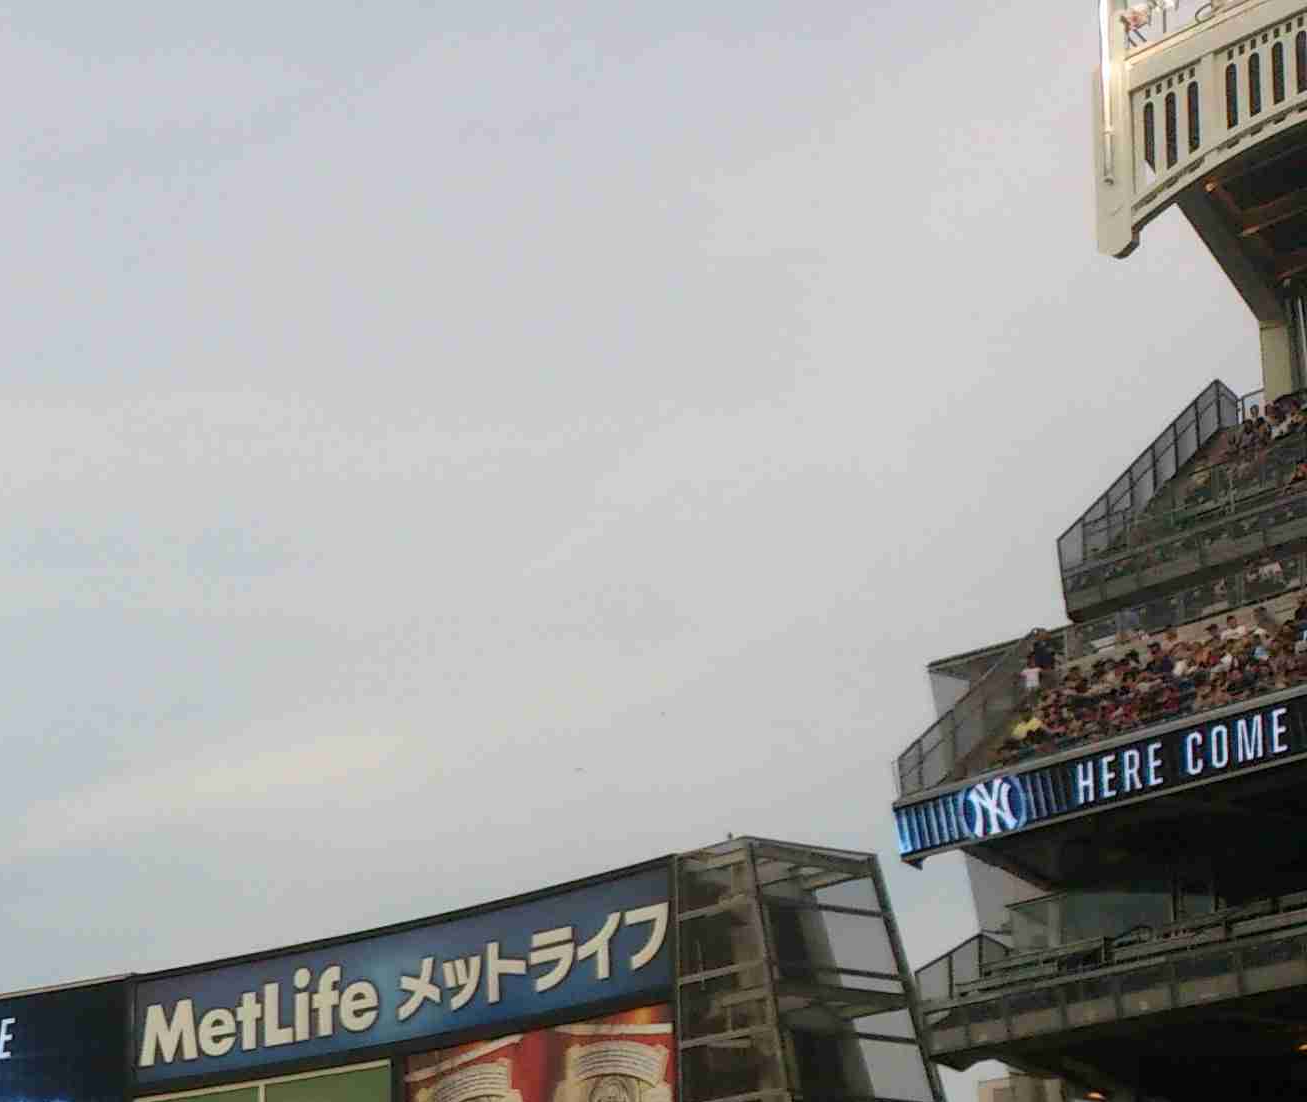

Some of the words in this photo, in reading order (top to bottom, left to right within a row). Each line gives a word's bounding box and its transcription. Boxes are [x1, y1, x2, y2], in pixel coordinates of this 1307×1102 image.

[1077, 742, 1164, 804] HERE
[1186, 707, 1289, 776] COME
[138, 965, 381, 1067] MetLife
[397, 902, 670, 1021] メットライフ
